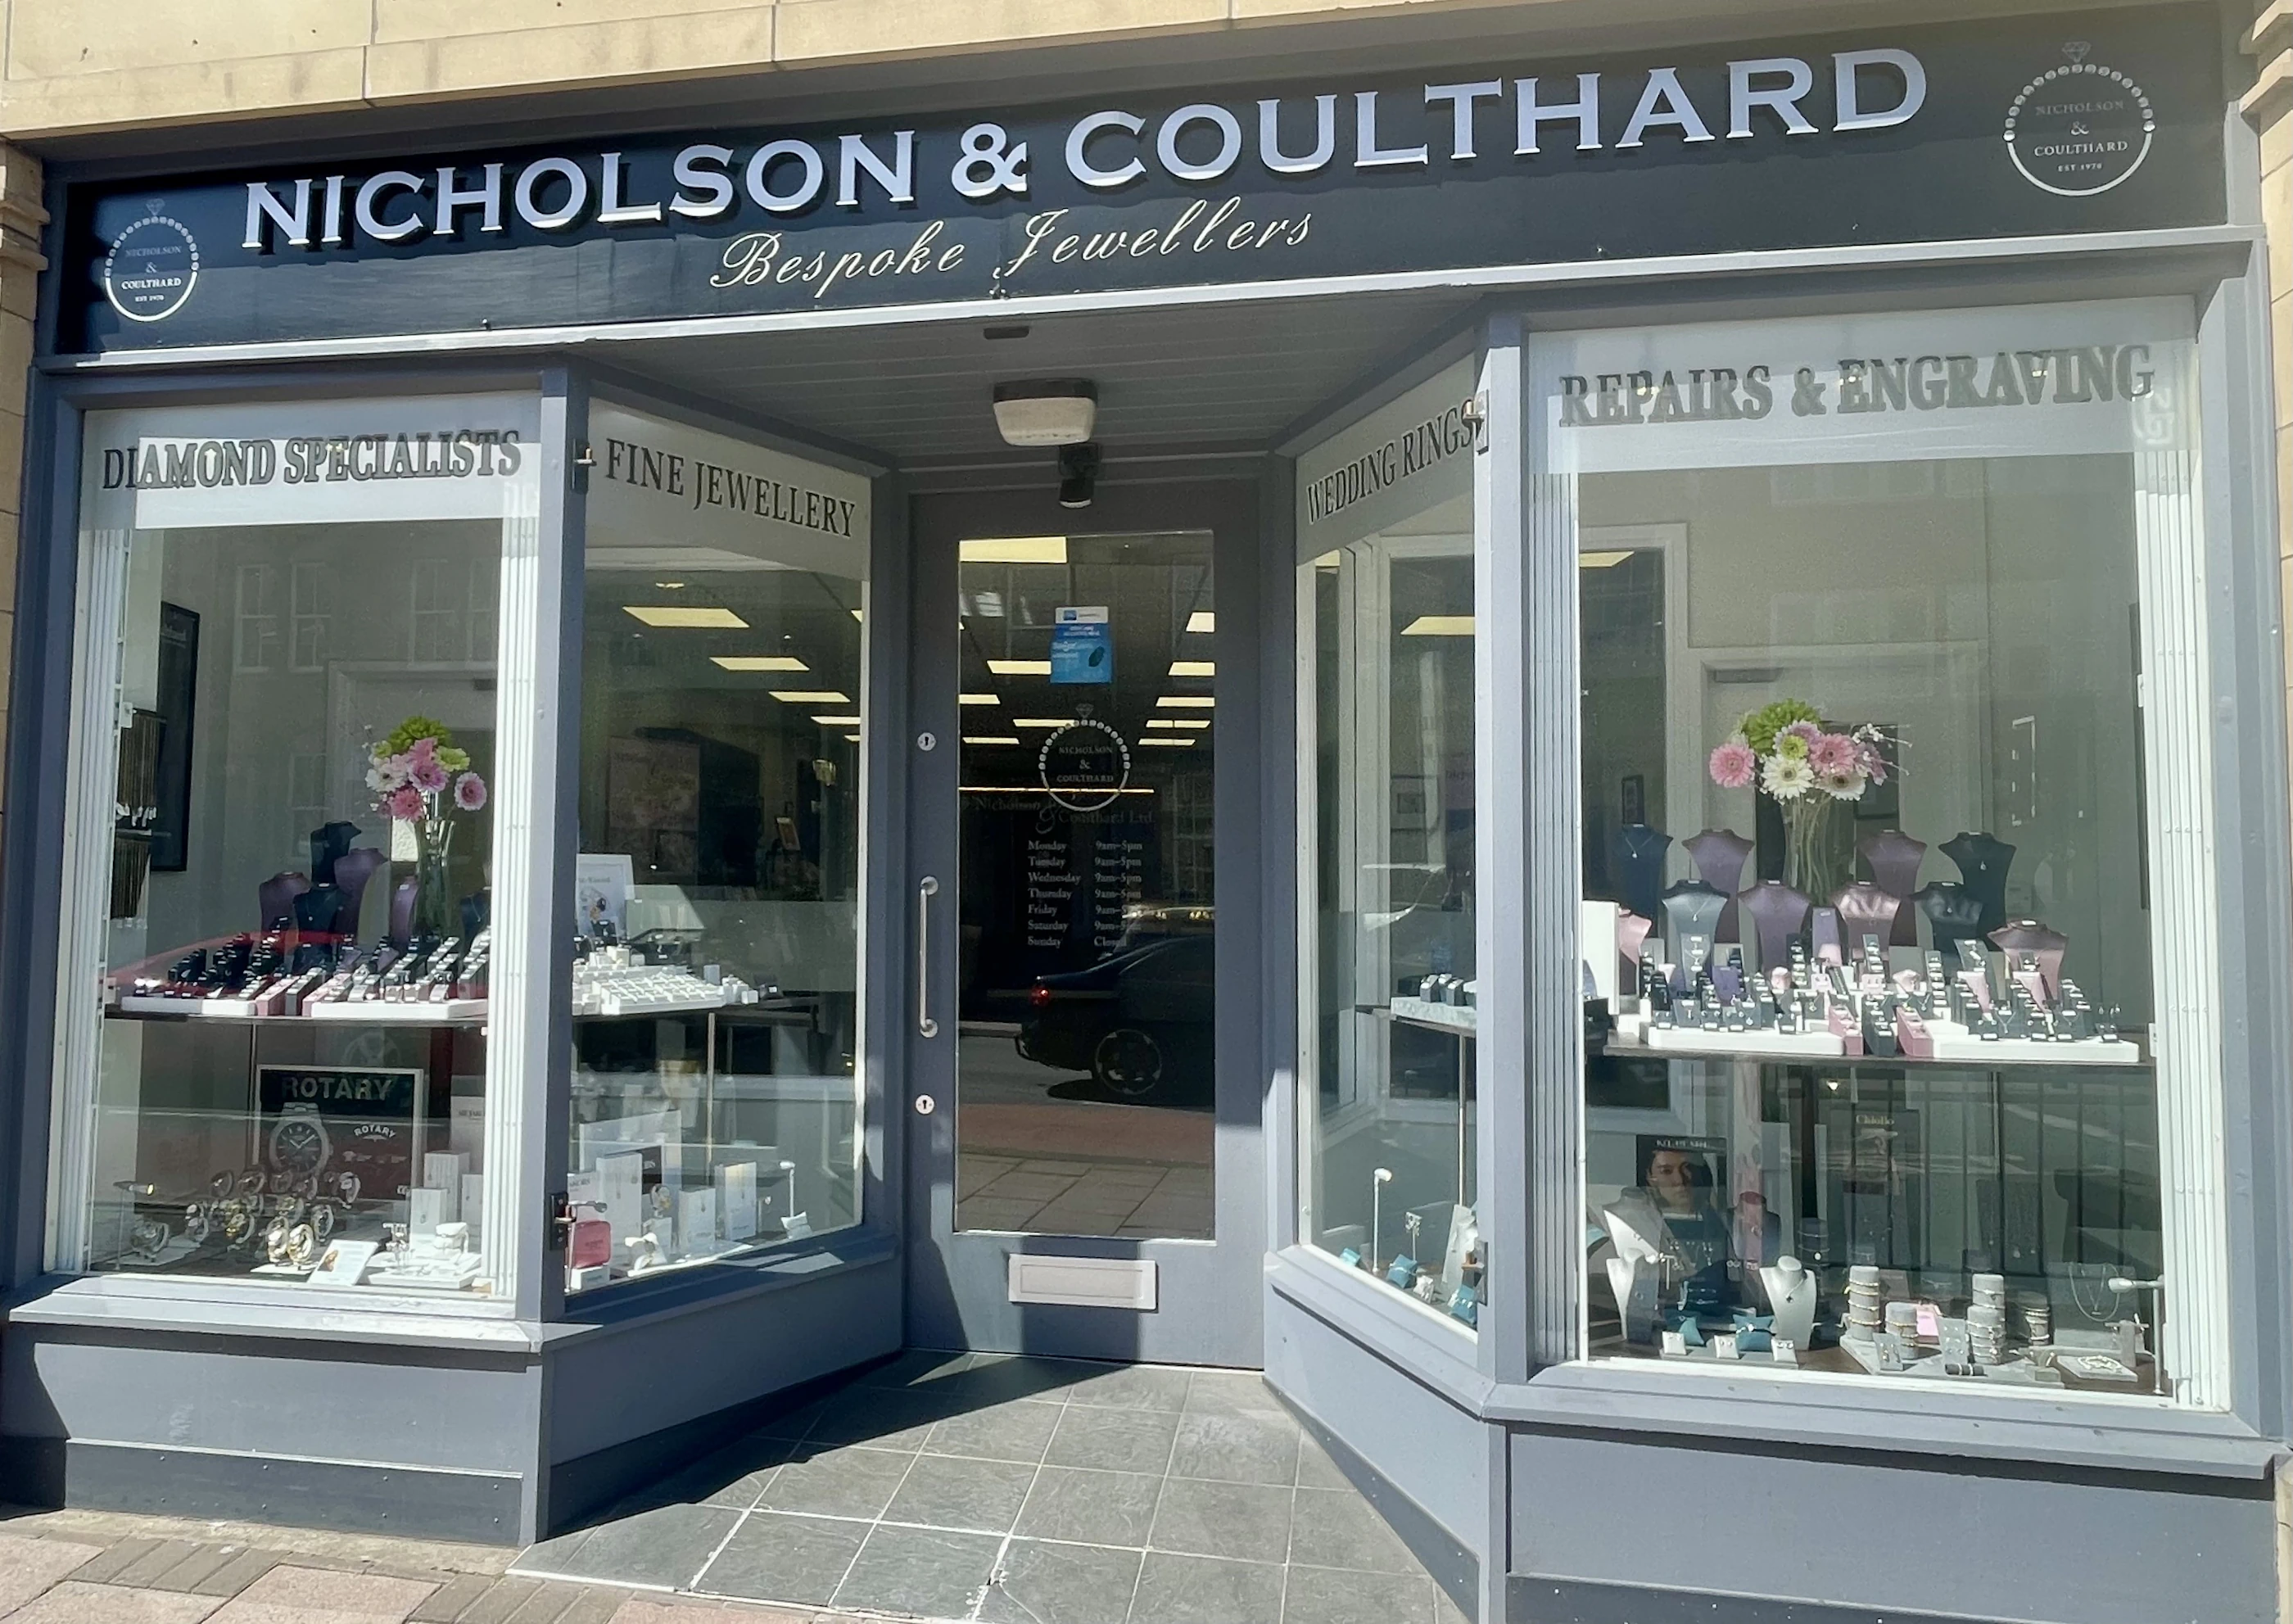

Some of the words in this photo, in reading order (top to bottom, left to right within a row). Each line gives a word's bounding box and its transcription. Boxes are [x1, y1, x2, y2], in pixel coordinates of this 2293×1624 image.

[2035, 100, 2124, 115] NICHOLSON
[2070, 120, 2090, 136] &
[242, 129, 916, 247] NICHOLSON
[952, 123, 1029, 198] &
[1065, 47, 1928, 187] COULTHARD
[2033, 140, 2128, 157] COULTHARD
[2057, 164, 2076, 172] EST
[124, 246, 182, 258] NICHOLSON
[709, 219, 966, 298] Bespoke
[992, 196, 1313, 279] Jewellers
[145, 261, 158, 274] &
[120, 278, 182, 289] COULTHARD
[1558, 364, 1771, 427] REPAIRS
[1791, 366, 1827, 417] &
[1837, 343, 2156, 415] ENGRAVING
[103, 439, 276, 490] DIAMOND
[283, 428, 522, 484] SPECIALISTS
[1307, 442, 1396, 524] WEDDING
[1402, 398, 1474, 477] RINGS
[606, 438, 685, 496] FINE
[694, 462, 856, 538] JEWELLERY
[1058, 746, 1114, 754] NICHOLSON
[1079, 758, 1092, 771] &
[1056, 774, 1115, 783] COULTHARD
[1028, 839, 1067, 853] Monday
[1028, 856, 1066, 869] Tuesday
[1028, 871, 1081, 885] Wednesday
[1028, 888, 1073, 900] Thursday
[1028, 904, 1058, 916] Friday
[1028, 920, 1070, 933] Saturday
[1027, 936, 1063, 948] Sunday
[282, 1077, 393, 1101] ROTARY
[353, 1124, 397, 1138] ROTARY
